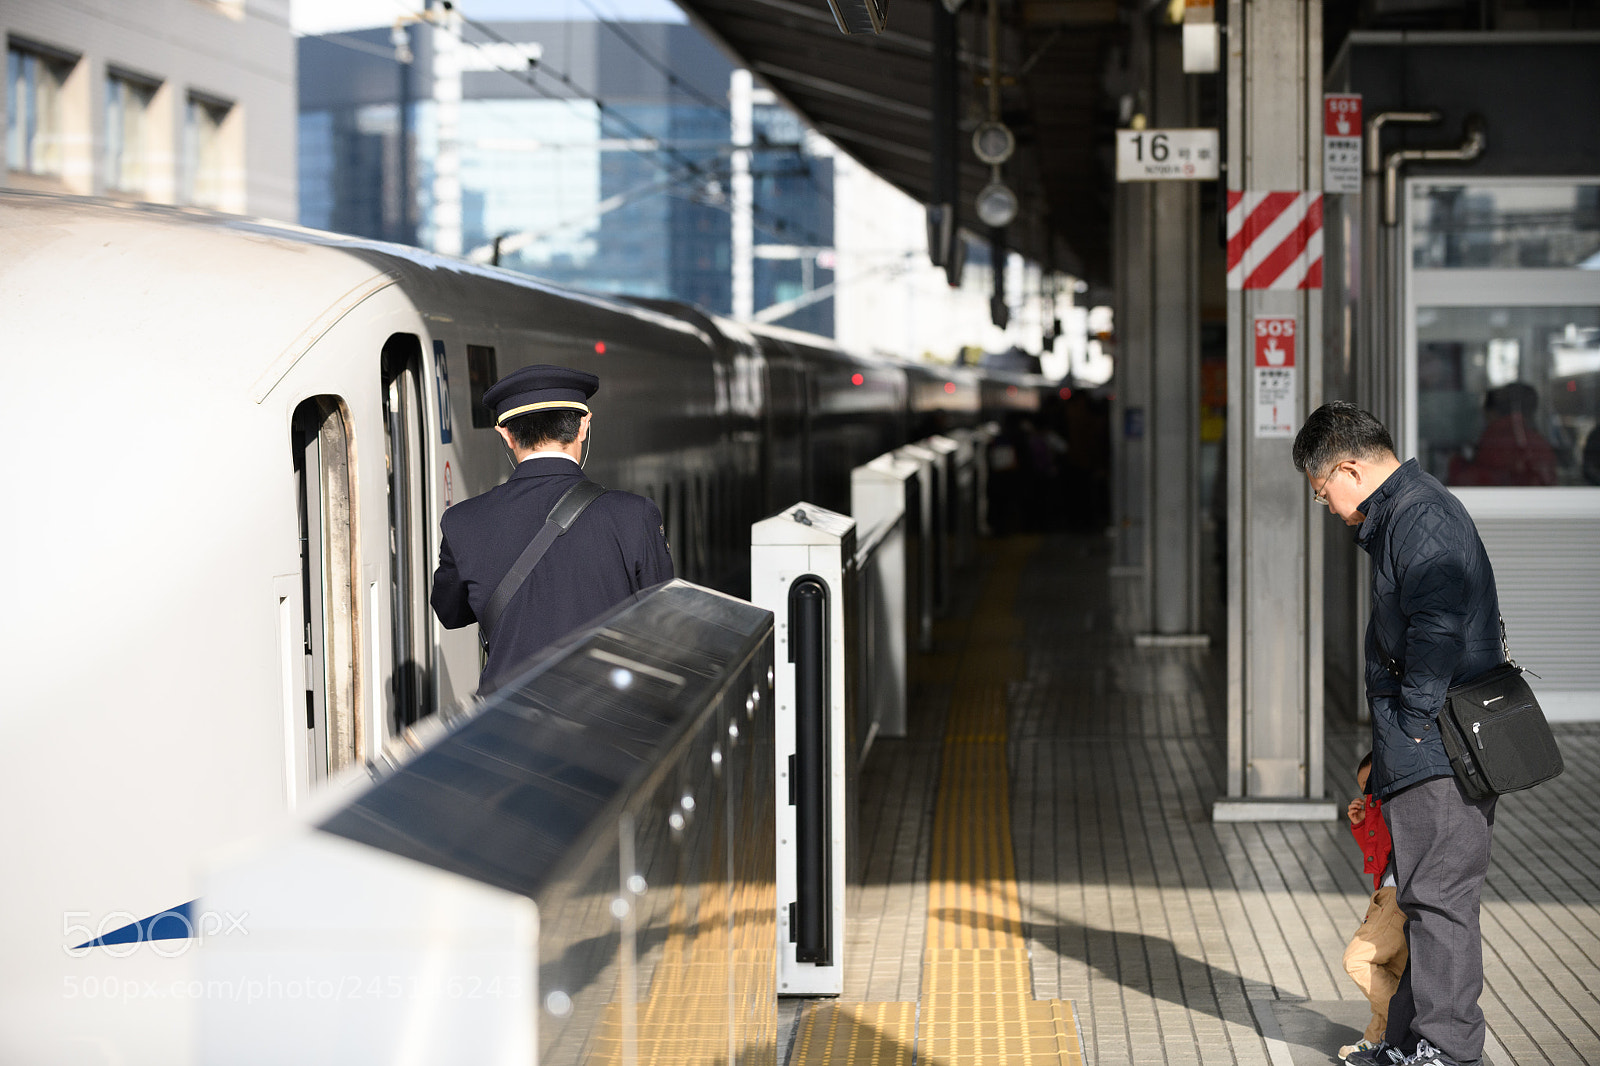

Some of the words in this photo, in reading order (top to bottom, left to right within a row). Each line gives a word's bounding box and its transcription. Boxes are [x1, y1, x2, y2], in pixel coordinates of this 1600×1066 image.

[1329, 100, 1359, 113] SOS
[1131, 133, 1169, 161] 16
[1257, 320, 1294, 337] SOS
[436, 352, 451, 431] 16
